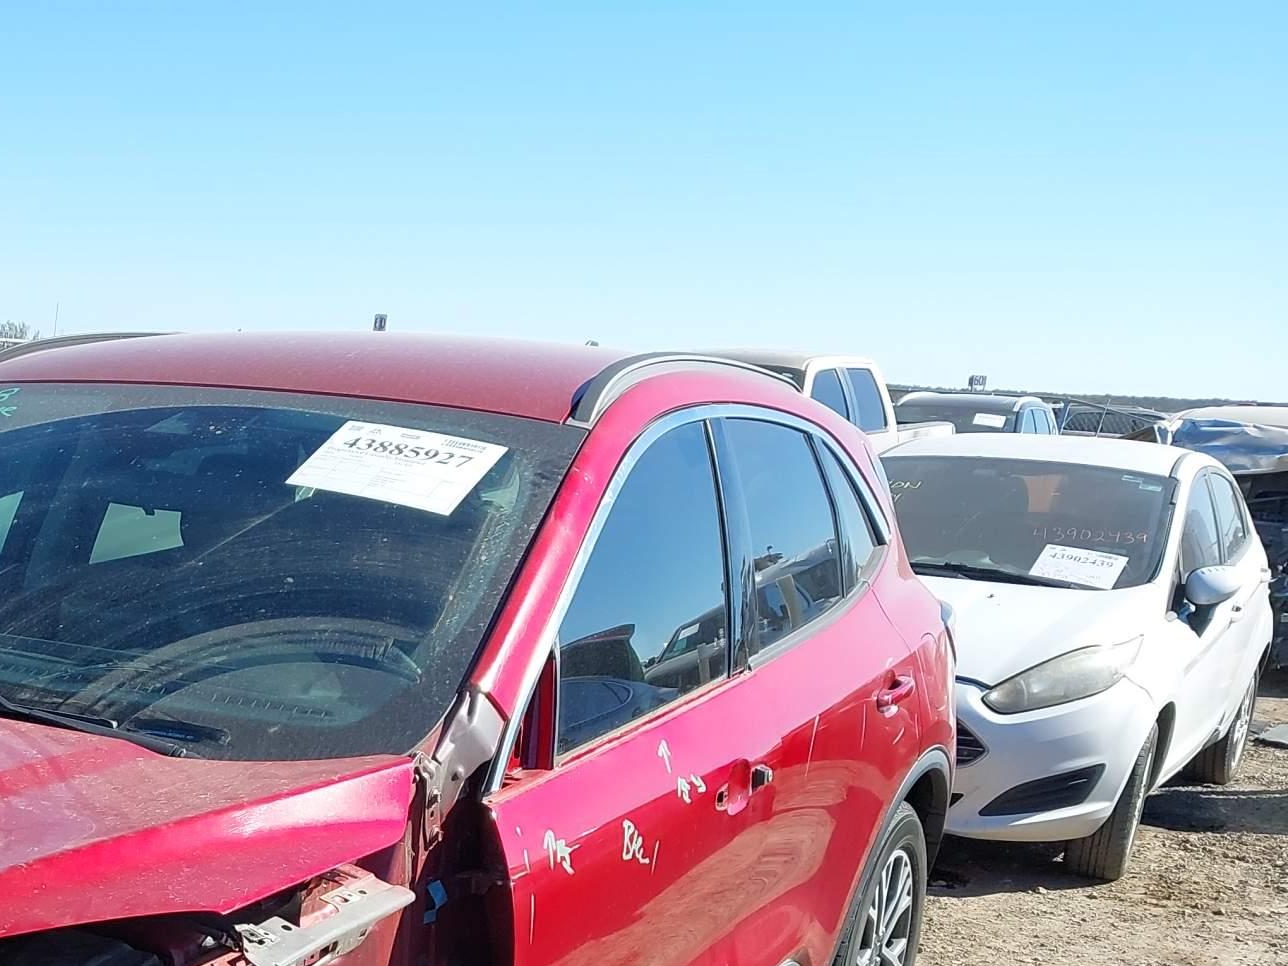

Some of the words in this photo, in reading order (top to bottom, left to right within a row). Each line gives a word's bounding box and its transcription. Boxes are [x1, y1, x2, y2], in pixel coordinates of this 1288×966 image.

[342, 435, 474, 468] 43885927
[1032, 526, 1150, 545] 43902439
[1047, 551, 1115, 569] 43902439
